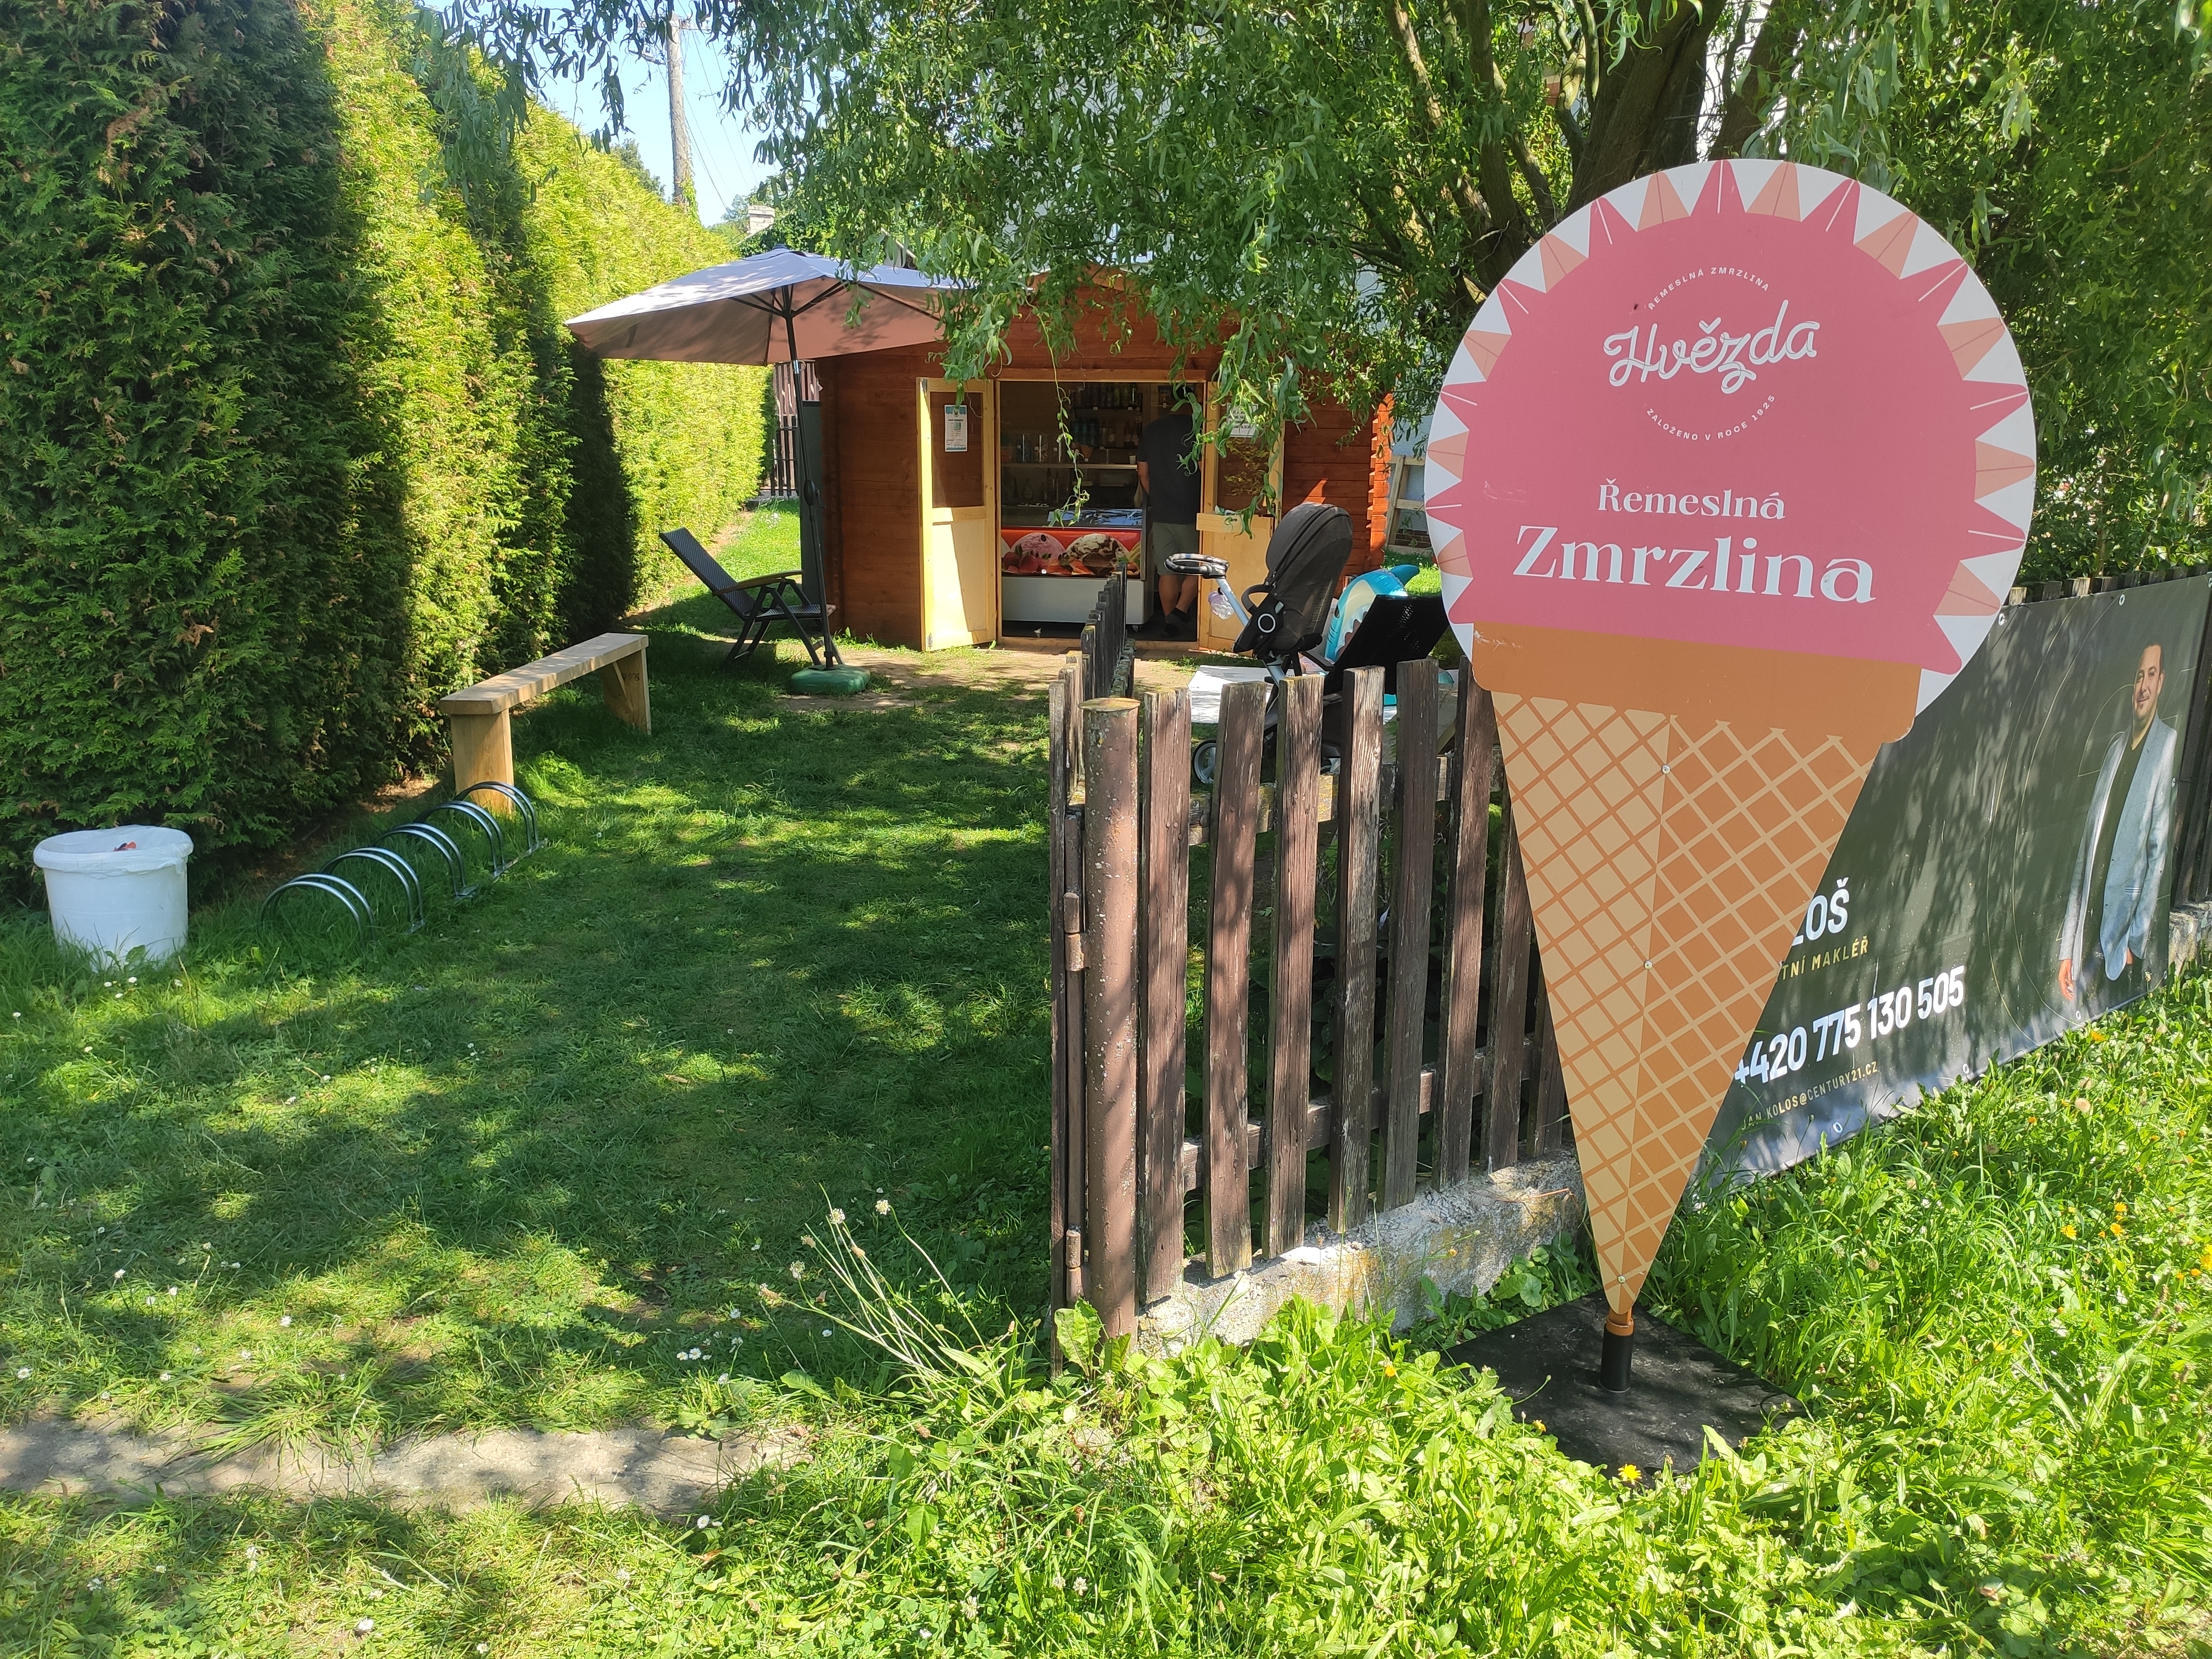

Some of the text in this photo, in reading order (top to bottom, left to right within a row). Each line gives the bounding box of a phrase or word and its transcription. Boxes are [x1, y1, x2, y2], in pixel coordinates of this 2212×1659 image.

[1647, 267, 1769, 310] ŘEMESLNÁ ZMRZLINA
[1603, 299, 1821, 394] Hvězda
[1646, 408, 1699, 441] ZALOŽENO
[1717, 421, 1748, 440] ROCE
[1751, 395, 1776, 421] 1925
[1597, 478, 1786, 520] Řemeslná
[1512, 525, 1876, 604] Zmrzlina
[1811, 935, 1869, 971] MAKLÉŘ
[1734, 965, 1965, 1086] +420 775 130 505
